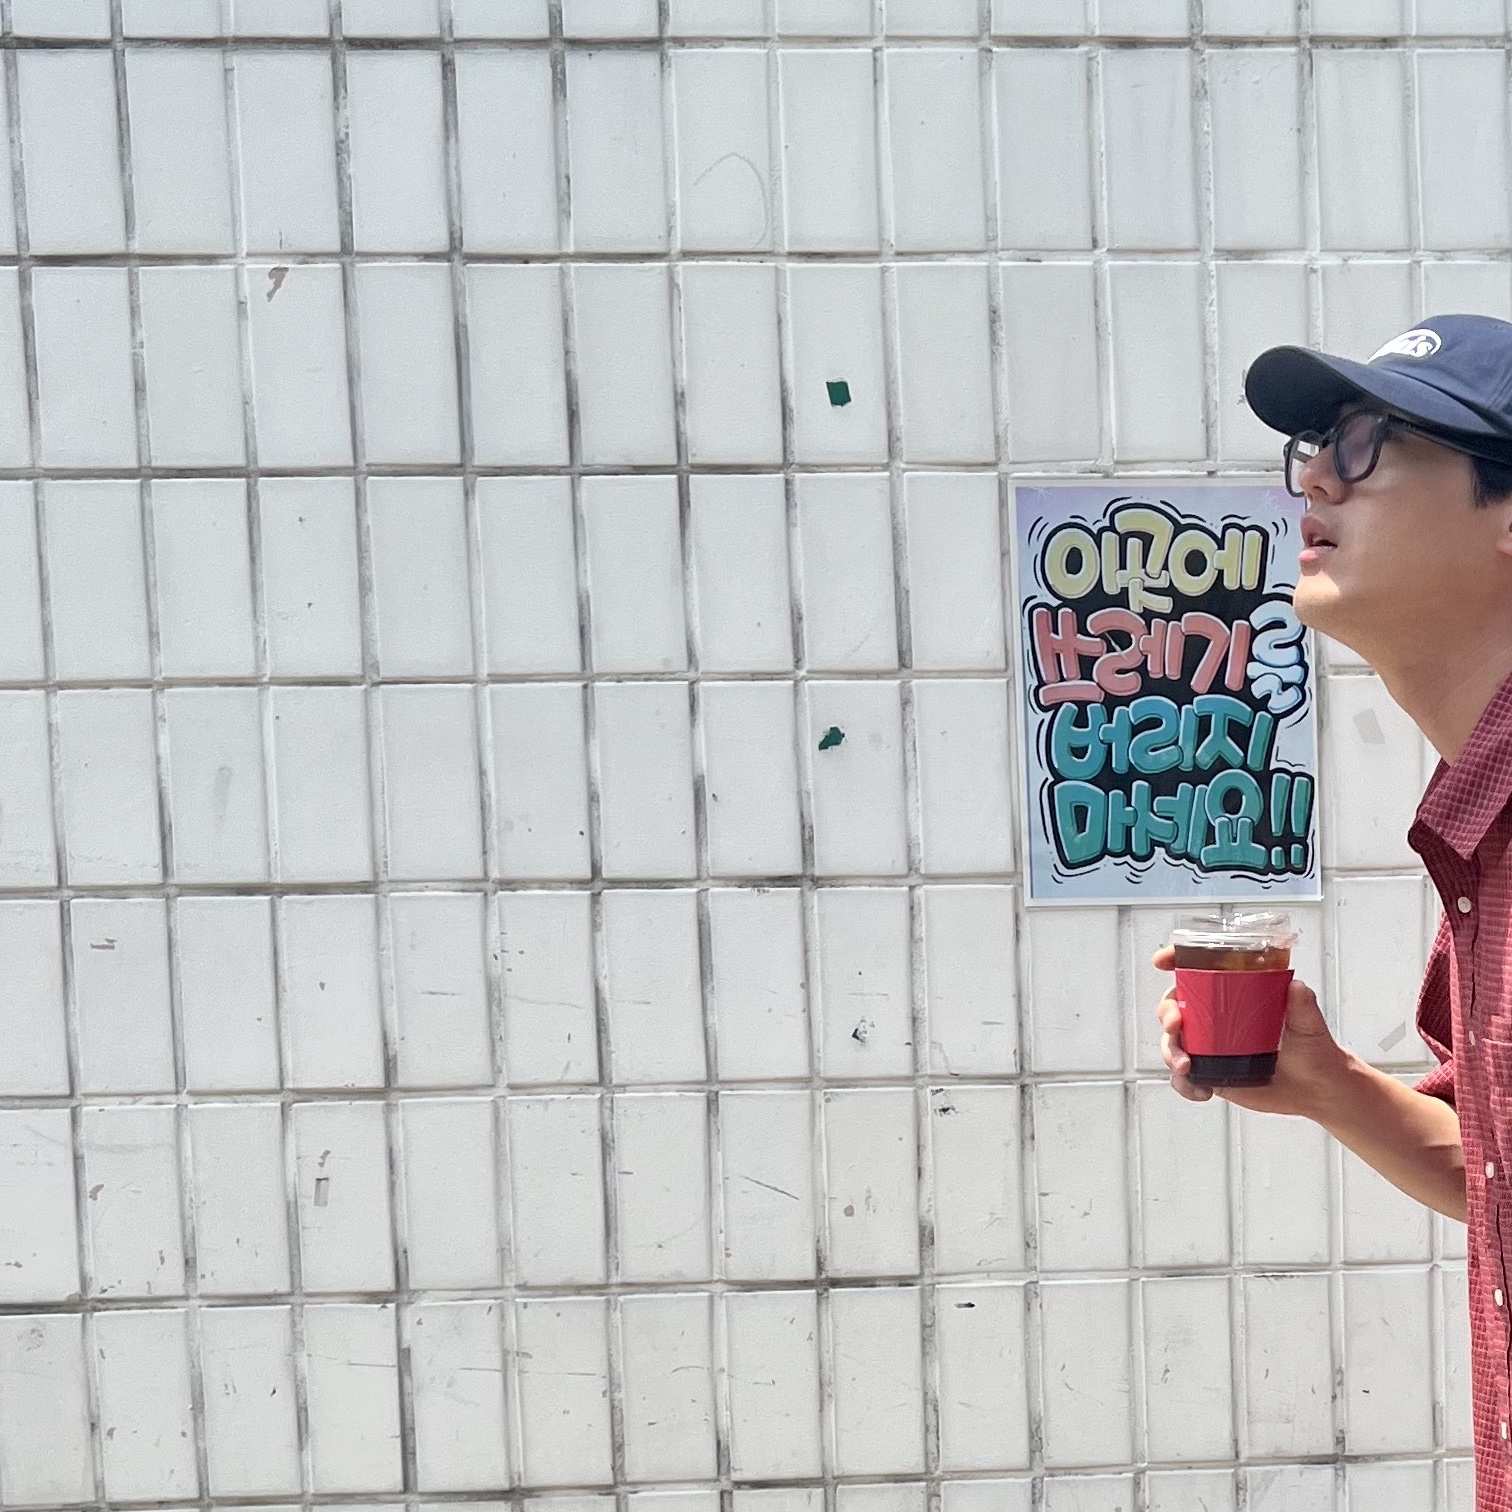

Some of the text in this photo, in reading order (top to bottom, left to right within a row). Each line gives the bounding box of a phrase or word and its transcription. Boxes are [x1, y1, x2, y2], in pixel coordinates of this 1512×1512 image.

[1045, 508, 1263, 613] 이곳에
[1032, 600, 1304, 714] 쓰레기를
[1051, 695, 1274, 779] 버리지
[1054, 769, 1312, 868] 마세요!!
